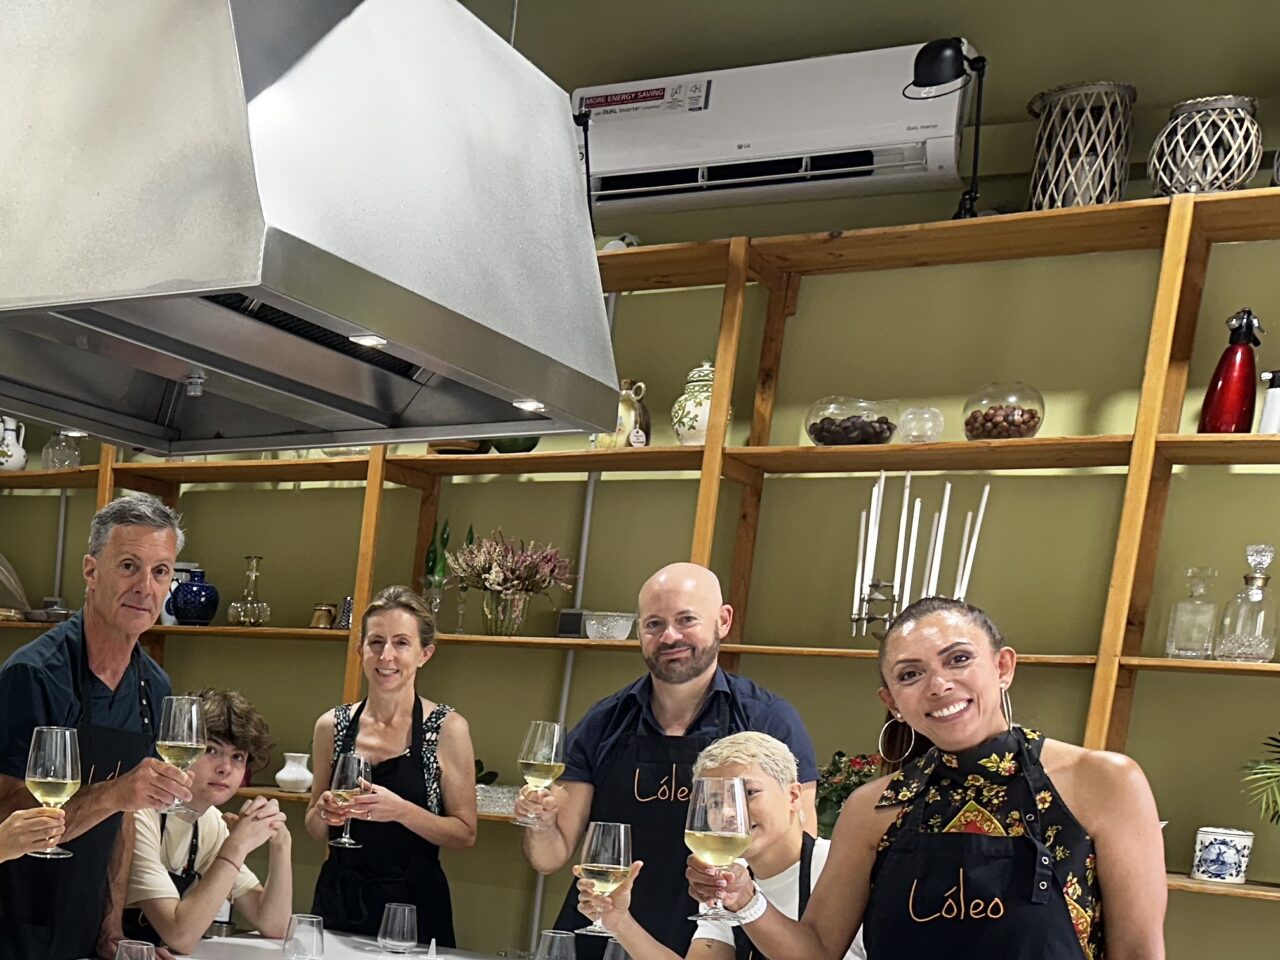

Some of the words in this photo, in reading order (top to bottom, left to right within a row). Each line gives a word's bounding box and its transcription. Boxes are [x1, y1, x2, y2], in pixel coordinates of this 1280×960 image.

[586, 97, 606, 105] MORE
[607, 92, 636, 102] ENERGY
[638, 89, 664, 99] SAVING
[634, 763, 693, 802] Lóle
[909, 867, 1004, 922] Lóleo
